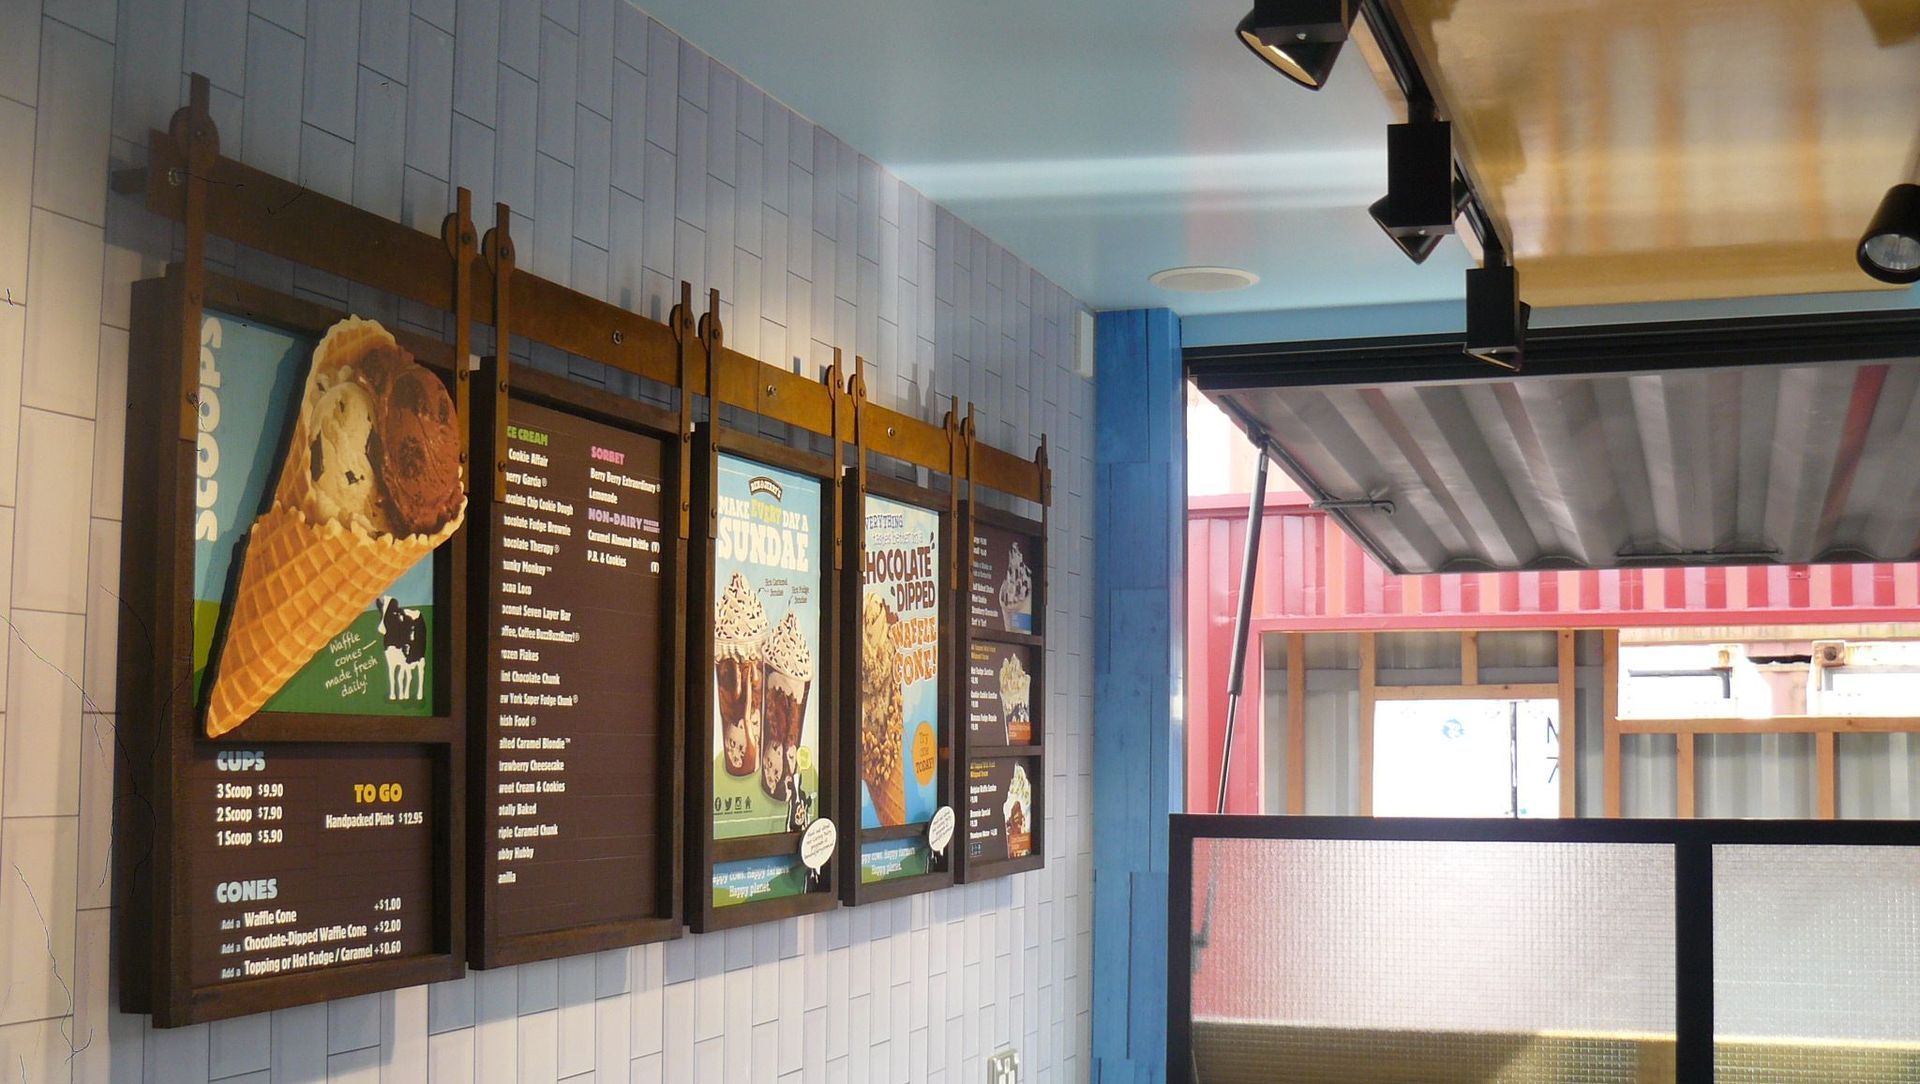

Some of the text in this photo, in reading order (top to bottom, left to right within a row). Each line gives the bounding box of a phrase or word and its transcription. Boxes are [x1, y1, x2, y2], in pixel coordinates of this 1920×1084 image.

[507, 426, 548, 446] CE CREAM
[509, 448, 530, 463] Cookie
[591, 446, 624, 465] SORBET
[590, 468, 605, 482] Berry
[607, 472, 621, 485] Berry
[589, 488, 618, 504] Lemonade
[527, 496, 538, 509] Chip
[539, 499, 556, 511] Cookie
[557, 502, 573, 516] Dough
[718, 496, 808, 532] MAKE EVERY DAY A
[504, 515, 571, 536] hocolate Fudge Brownie
[588, 508, 643, 529] NON-DAIRY
[865, 515, 903, 531] VERYTHING
[504, 538, 529, 550] hocolate
[588, 529, 610, 544] Caramel
[611, 533, 631, 547] Almond
[633, 537, 649, 551] Brittle
[718, 517, 808, 572] SUNDAE
[503, 560, 521, 573] unky
[587, 550, 599, 563] P.B.
[600, 552, 605, 564] &
[606, 554, 626, 567] Cookies
[863, 547, 932, 584] HOCOLATE
[518, 583, 532, 595] Loco
[897, 581, 935, 611] DIPPED
[523, 605, 541, 618] Seven
[543, 607, 559, 620] Layer
[560, 609, 571, 621] Bar
[518, 627, 535, 639] Coffee
[890, 617, 936, 649] WAFFLE
[330, 632, 360, 653] Waffle
[336, 649, 361, 667] cones
[519, 649, 539, 661] Flakes
[326, 656, 378, 689] made fresh
[893, 646, 936, 686] CONE!
[342, 674, 368, 696] daily!
[512, 671, 541, 683] Chocolate
[542, 673, 560, 685] Chunk
[500, 694, 509, 704] ew
[510, 693, 523, 704] York
[524, 694, 539, 705] Super
[540, 694, 556, 707] Fudge
[500, 738, 515, 749] alted
[517, 738, 541, 749] Caramel
[217, 751, 265, 771] CUPS
[530, 760, 564, 771] Cheesecake
[217, 783, 283, 799] 3 Scoop $9.90
[354, 784, 402, 803] TO GO
[516, 782, 535, 793] Cream
[536, 782, 541, 792] &
[543, 781, 565, 792] Cookies
[217, 806, 282, 822] 2 Scoop $7.90
[499, 803, 536, 816] otally Baked
[326, 812, 423, 829] Handpacked Pints $12.95
[217, 830, 282, 846] 1 Scoop $5.90
[499, 824, 558, 838] riple Caramel Chunk
[514, 847, 534, 858] Hubby
[498, 871, 516, 883] anilla
[713, 873, 728, 884] appy
[217, 879, 277, 903] CONES
[221, 919, 234, 930] Add
[244, 911, 274, 927] Waffle
[276, 909, 296, 924] Cone
[221, 944, 234, 954] Add
[244, 928, 318, 952] Chocolate-Dipped
[320, 925, 346, 942] Waffle
[348, 923, 367, 938] Cone
[221, 968, 234, 978] Add
[236, 969, 240, 977] a
[244, 957, 280, 976] Topping
[282, 958, 291, 970] or
[293, 954, 307, 969] Hot
[309, 950, 334, 967] Fudge
[336, 949, 339, 962] /
[341, 944, 372, 962] Caramel
